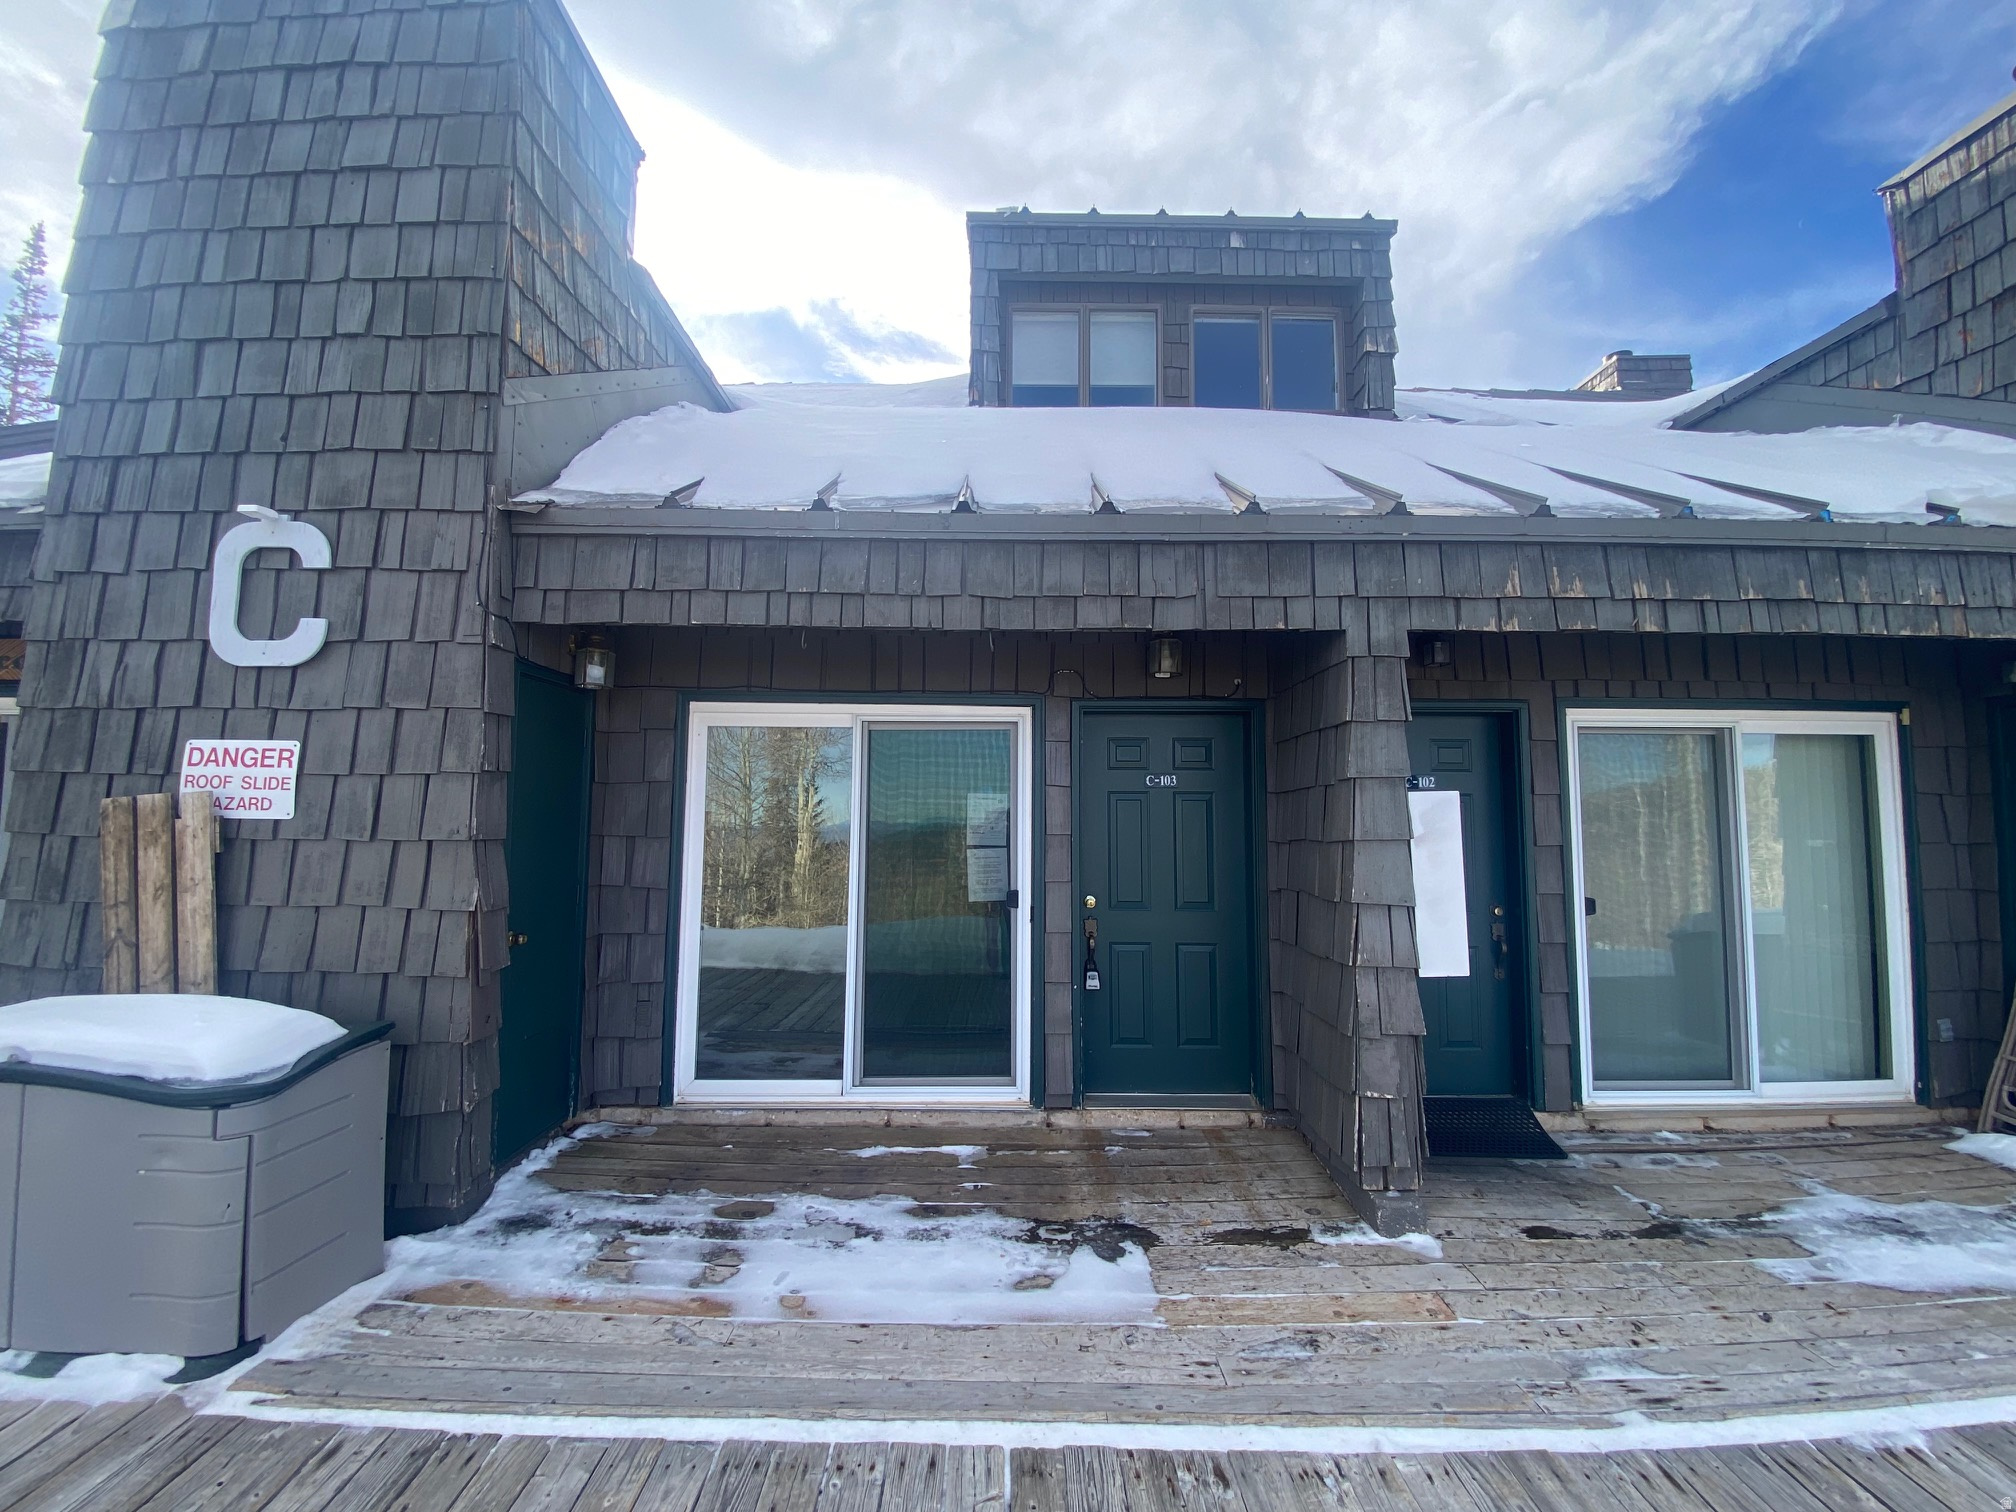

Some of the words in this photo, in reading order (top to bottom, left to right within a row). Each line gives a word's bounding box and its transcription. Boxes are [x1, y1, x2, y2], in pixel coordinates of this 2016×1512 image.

[209, 520, 333, 667] C
[187, 746, 295, 768] DANGER
[184, 774, 233, 789] ROOF
[240, 776, 292, 791] SLIDE
[1145, 775, 1177, 786] C-103
[1405, 776, 1436, 788] C-102
[212, 796, 273, 811] AZARD
